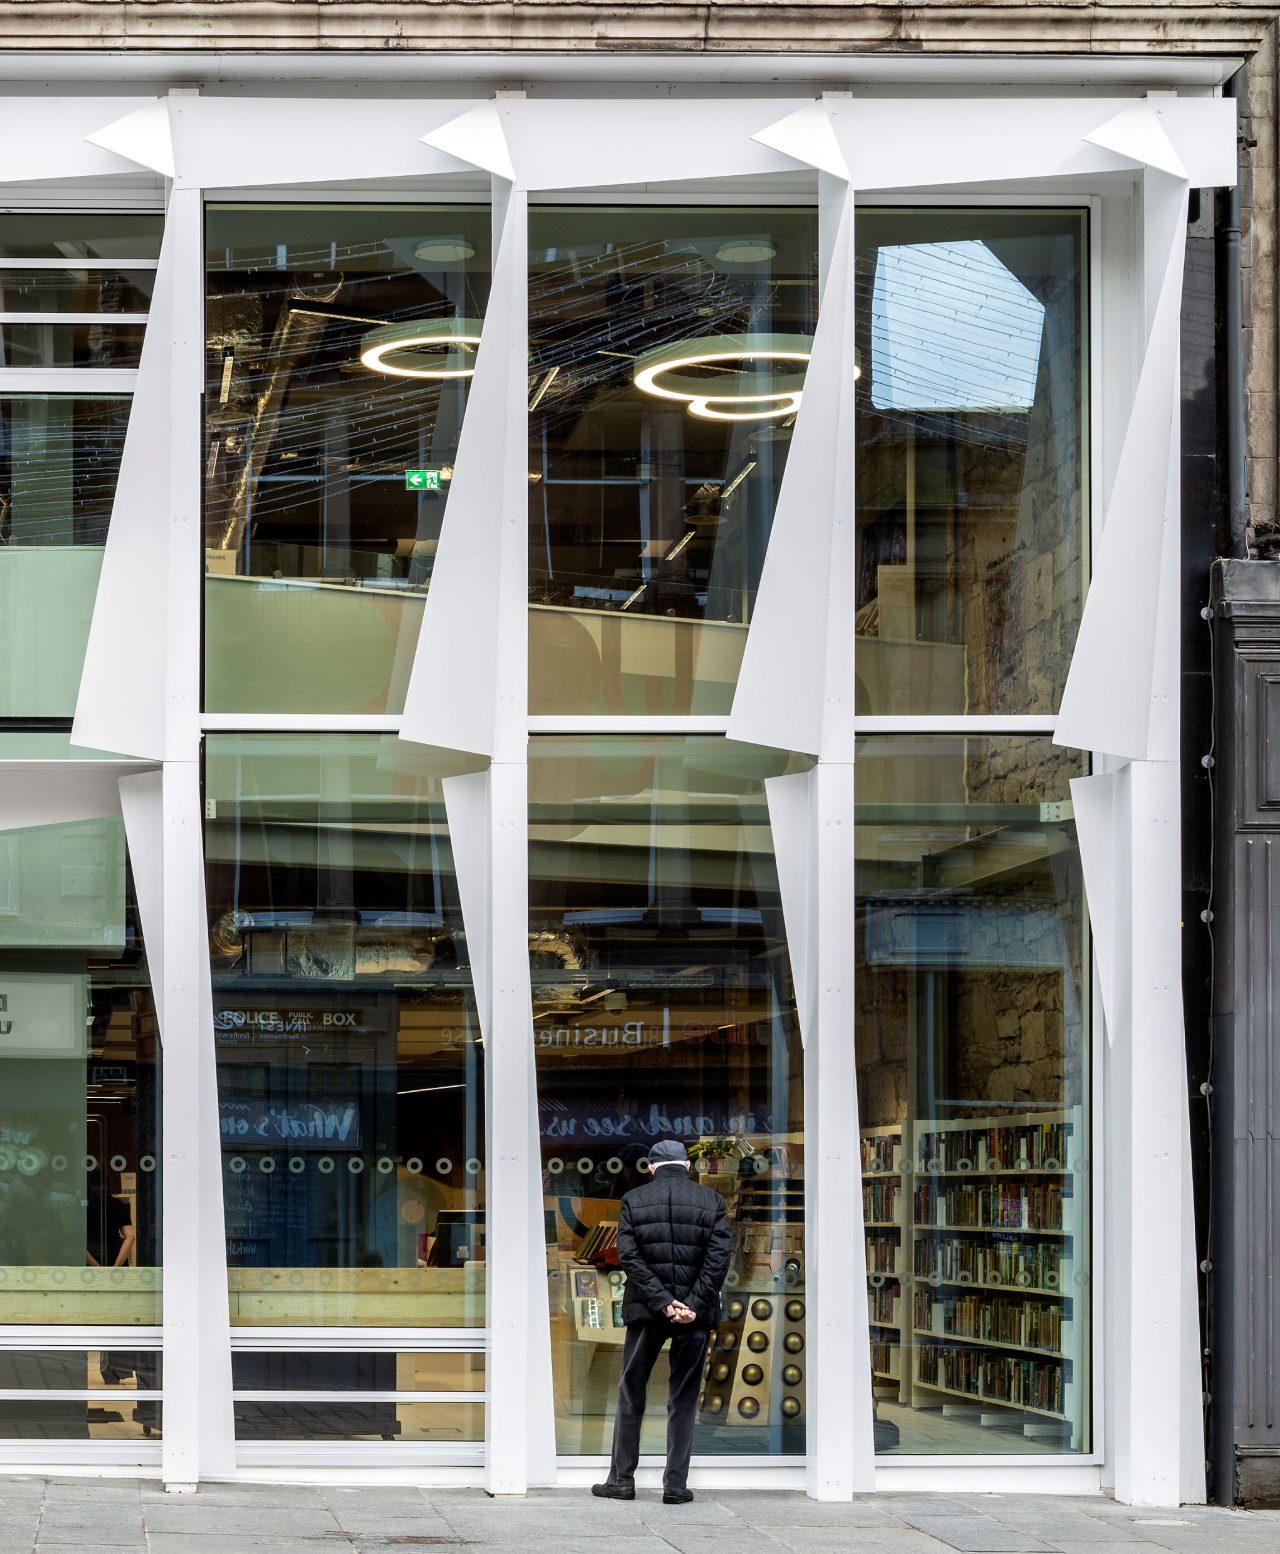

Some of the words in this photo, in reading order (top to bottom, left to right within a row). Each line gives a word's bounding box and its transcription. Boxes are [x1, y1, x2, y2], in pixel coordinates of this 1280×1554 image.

[223, 1011, 279, 1025] POLICE
[288, 1011, 314, 1019] PUBLIC
[323, 1012, 357, 1026] BOX
